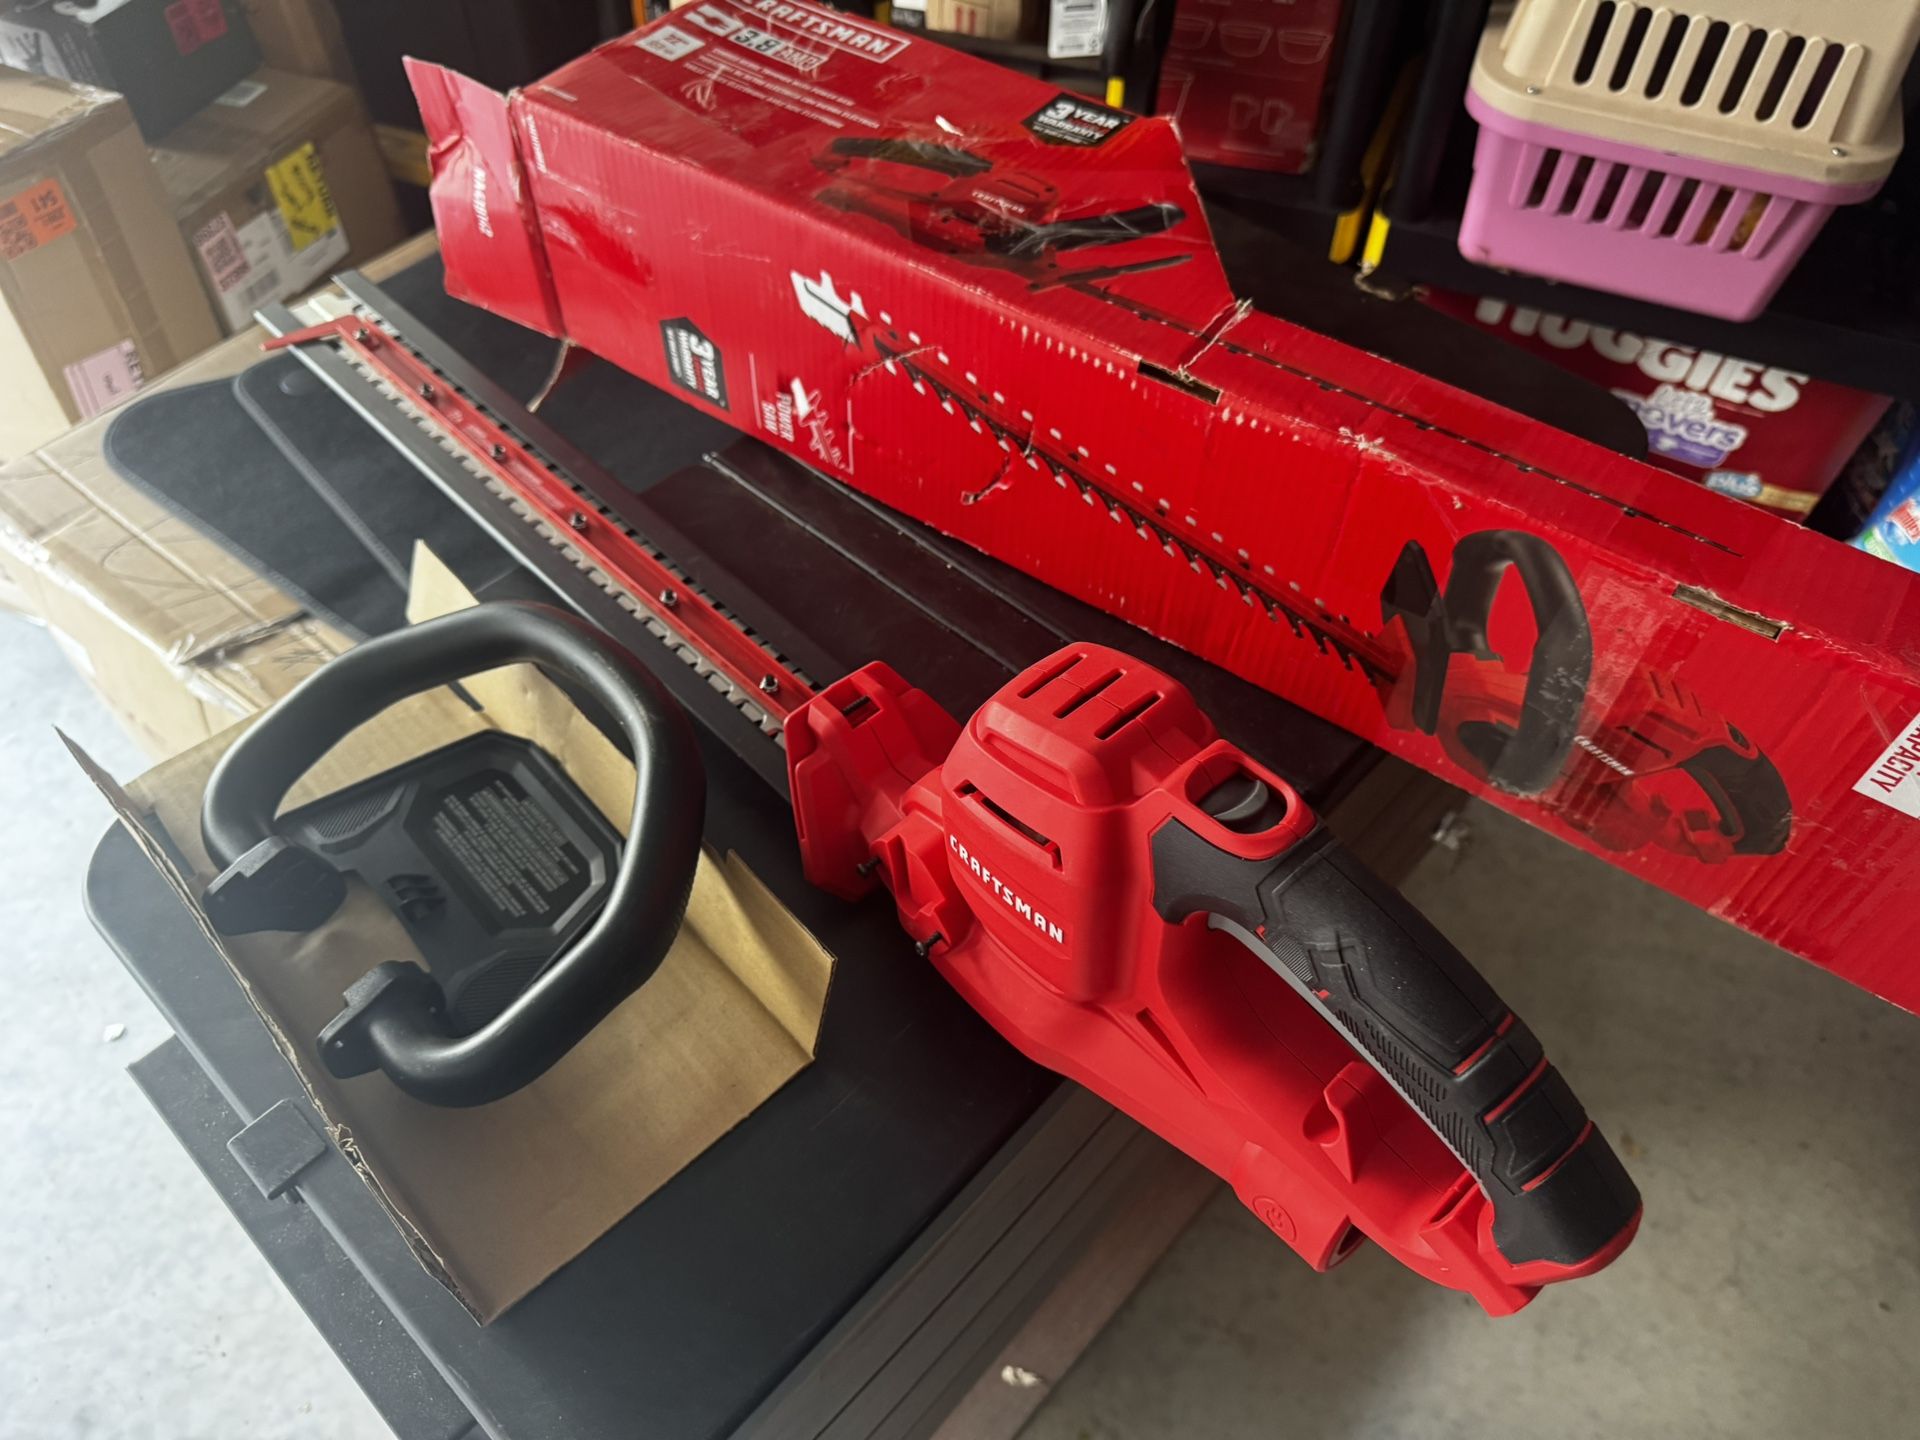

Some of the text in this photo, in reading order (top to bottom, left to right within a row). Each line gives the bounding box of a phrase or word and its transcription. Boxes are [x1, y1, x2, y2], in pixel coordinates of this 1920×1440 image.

[742, 0, 891, 54] RAFTSMAN
[1037, 114, 1105, 140] WARRANTY
[1044, 100, 1076, 121] 3
[1073, 108, 1121, 130] YEAR
[676, 327, 698, 390] WARRANTY
[688, 332, 715, 361] 3
[699, 359, 721, 400] YEAR
[761, 400, 779, 436] SAW
[775, 391, 795, 442] POWER
[1574, 735, 1634, 776] CRAFTSMAN
[949, 834, 1063, 944] CRAFTSMAN
